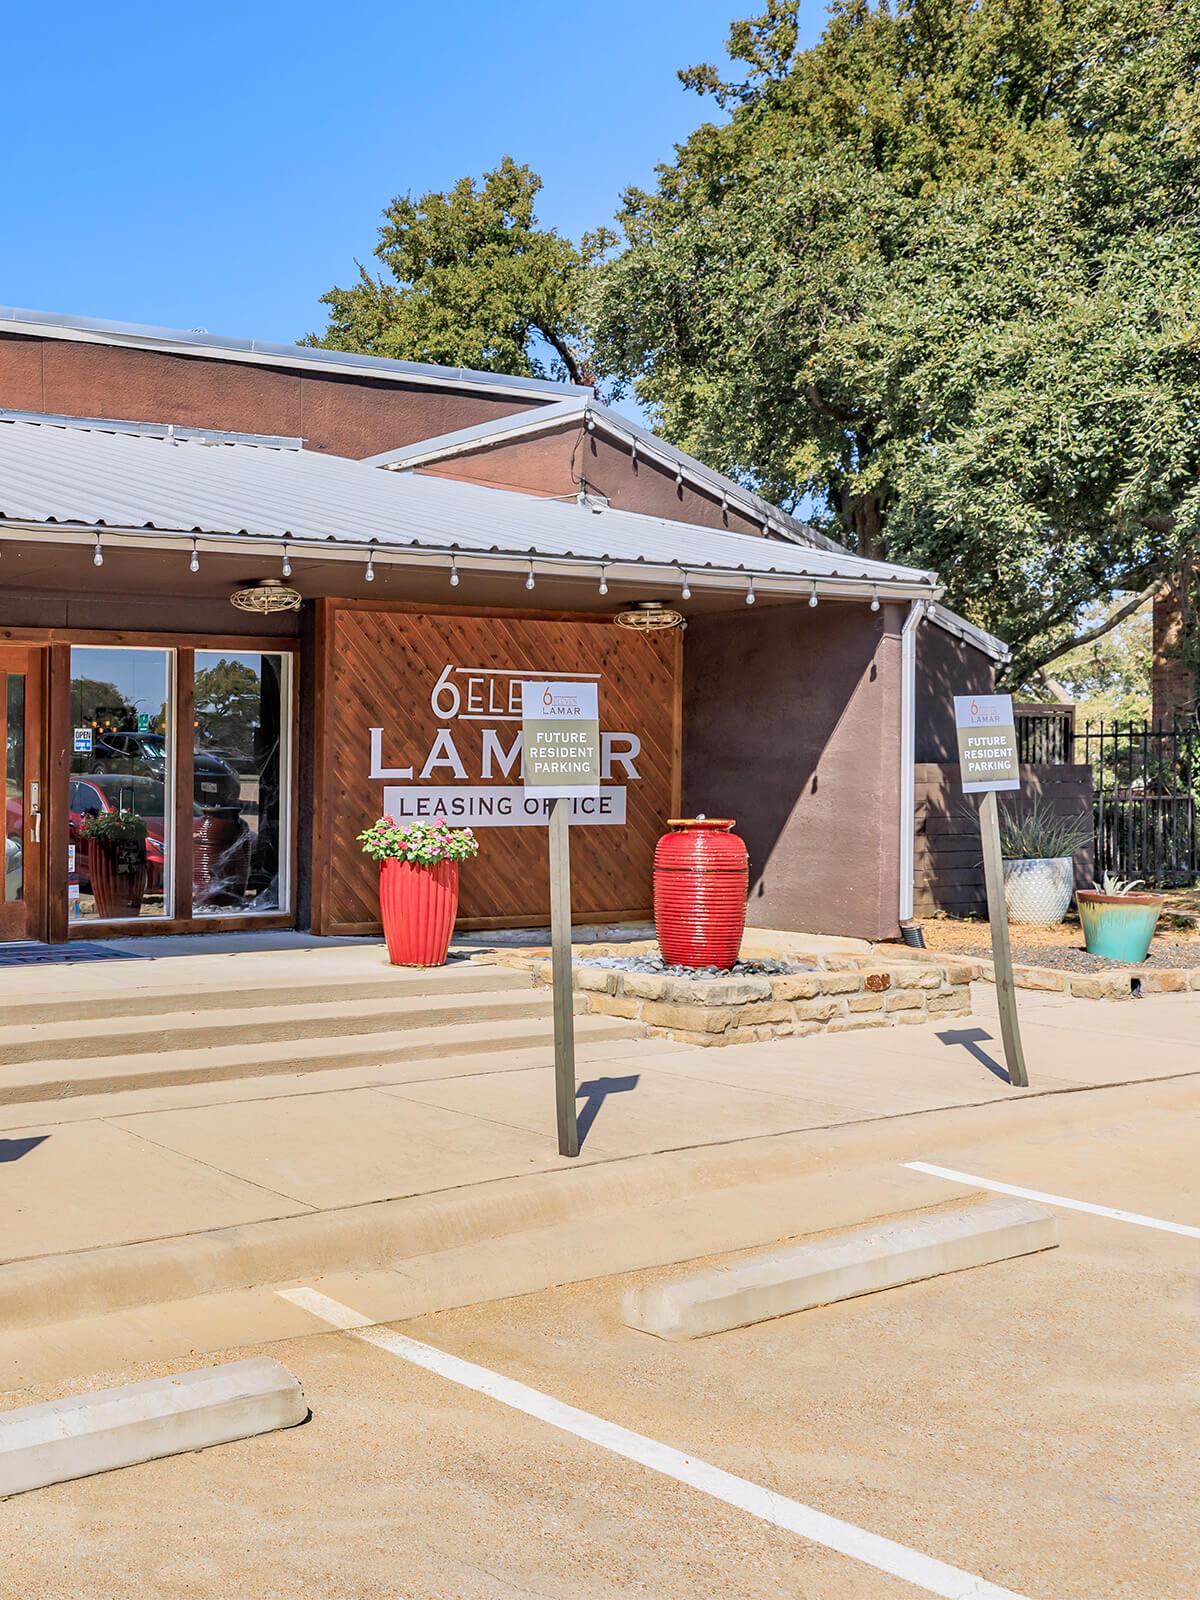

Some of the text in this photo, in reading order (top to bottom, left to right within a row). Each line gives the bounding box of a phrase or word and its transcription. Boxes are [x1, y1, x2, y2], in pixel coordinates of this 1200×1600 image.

[431, 664, 523, 720] 6 ELE
[543, 686, 553, 706] 6
[543, 707, 581, 715] LAMAR
[971, 715, 1000, 723] LAMAR
[536, 732, 587, 743] FUTURE
[968, 736, 1007, 746] FUTURE
[368, 727, 642, 781] LAMR
[530, 747, 594, 758] RESIDENT
[964, 748, 1013, 759] RESIDENT
[534, 762, 591, 773] PARKING
[968, 761, 1011, 772] PARKING
[400, 796, 612, 816] LEASING OFICE
